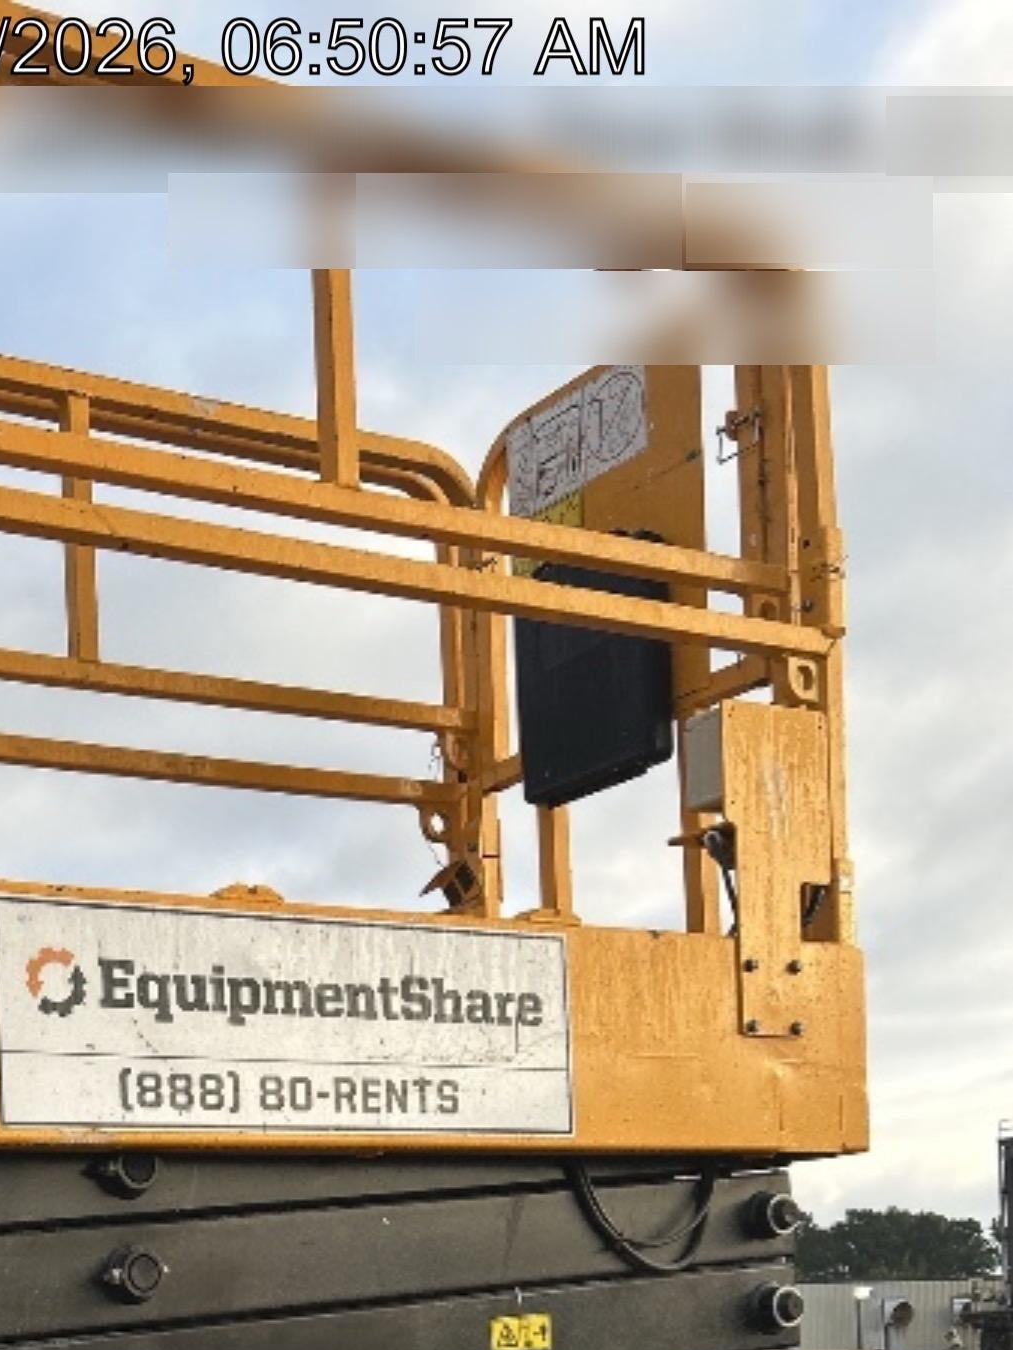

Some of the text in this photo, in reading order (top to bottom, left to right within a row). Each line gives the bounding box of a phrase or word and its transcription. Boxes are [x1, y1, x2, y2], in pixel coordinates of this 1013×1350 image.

[98, 958, 543, 1027] EquipmentShare
[119, 1067, 460, 1116] (888) 80-RENTS
